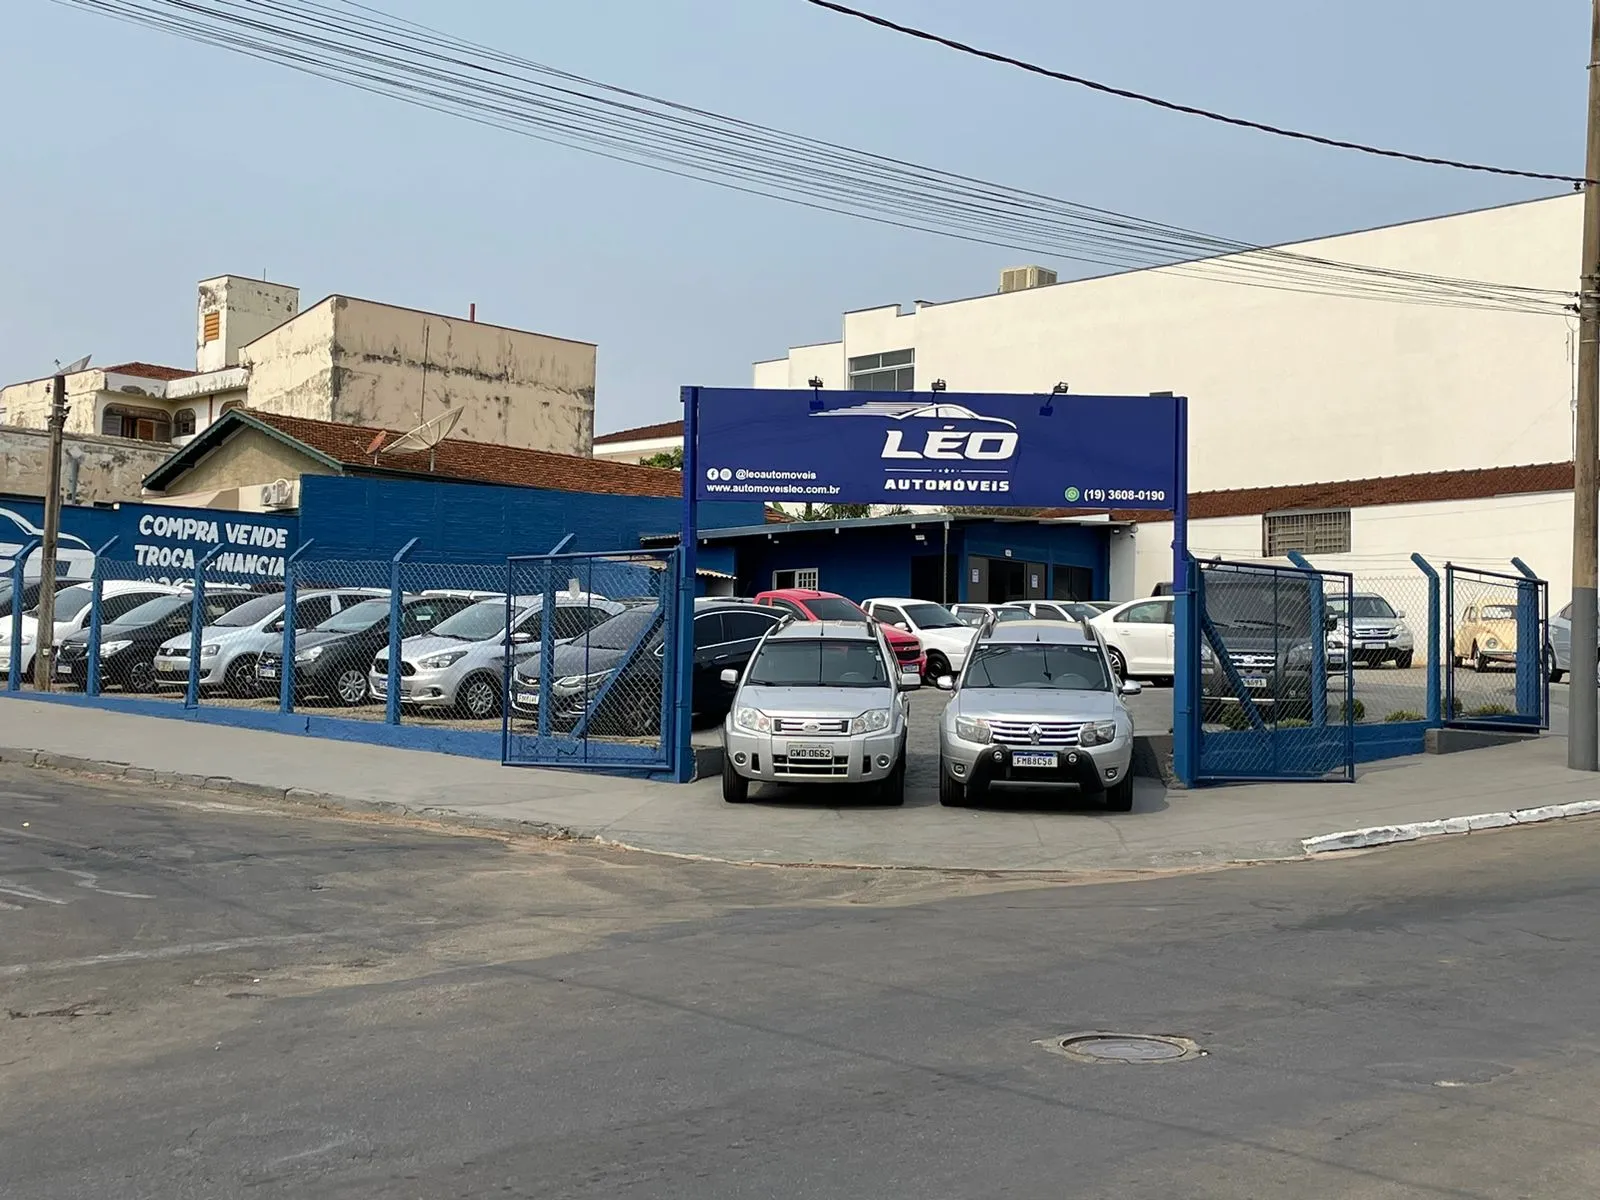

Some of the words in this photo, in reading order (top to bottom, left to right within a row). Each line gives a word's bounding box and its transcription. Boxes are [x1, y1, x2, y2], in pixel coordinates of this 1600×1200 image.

[881, 425, 1019, 460] LÉO
[735, 469, 817, 480] @leoautomoveis
[706, 484, 840, 494] www.automoveisleo.com.br
[884, 478, 1010, 492] AUTOMÓVEIS
[1084, 489, 1105, 502] (19)
[1108, 490, 1165, 501] 3608-0190
[139, 514, 219, 544] COMPRA
[225, 523, 289, 549] VENDE
[134, 544, 195, 569] TROCA
